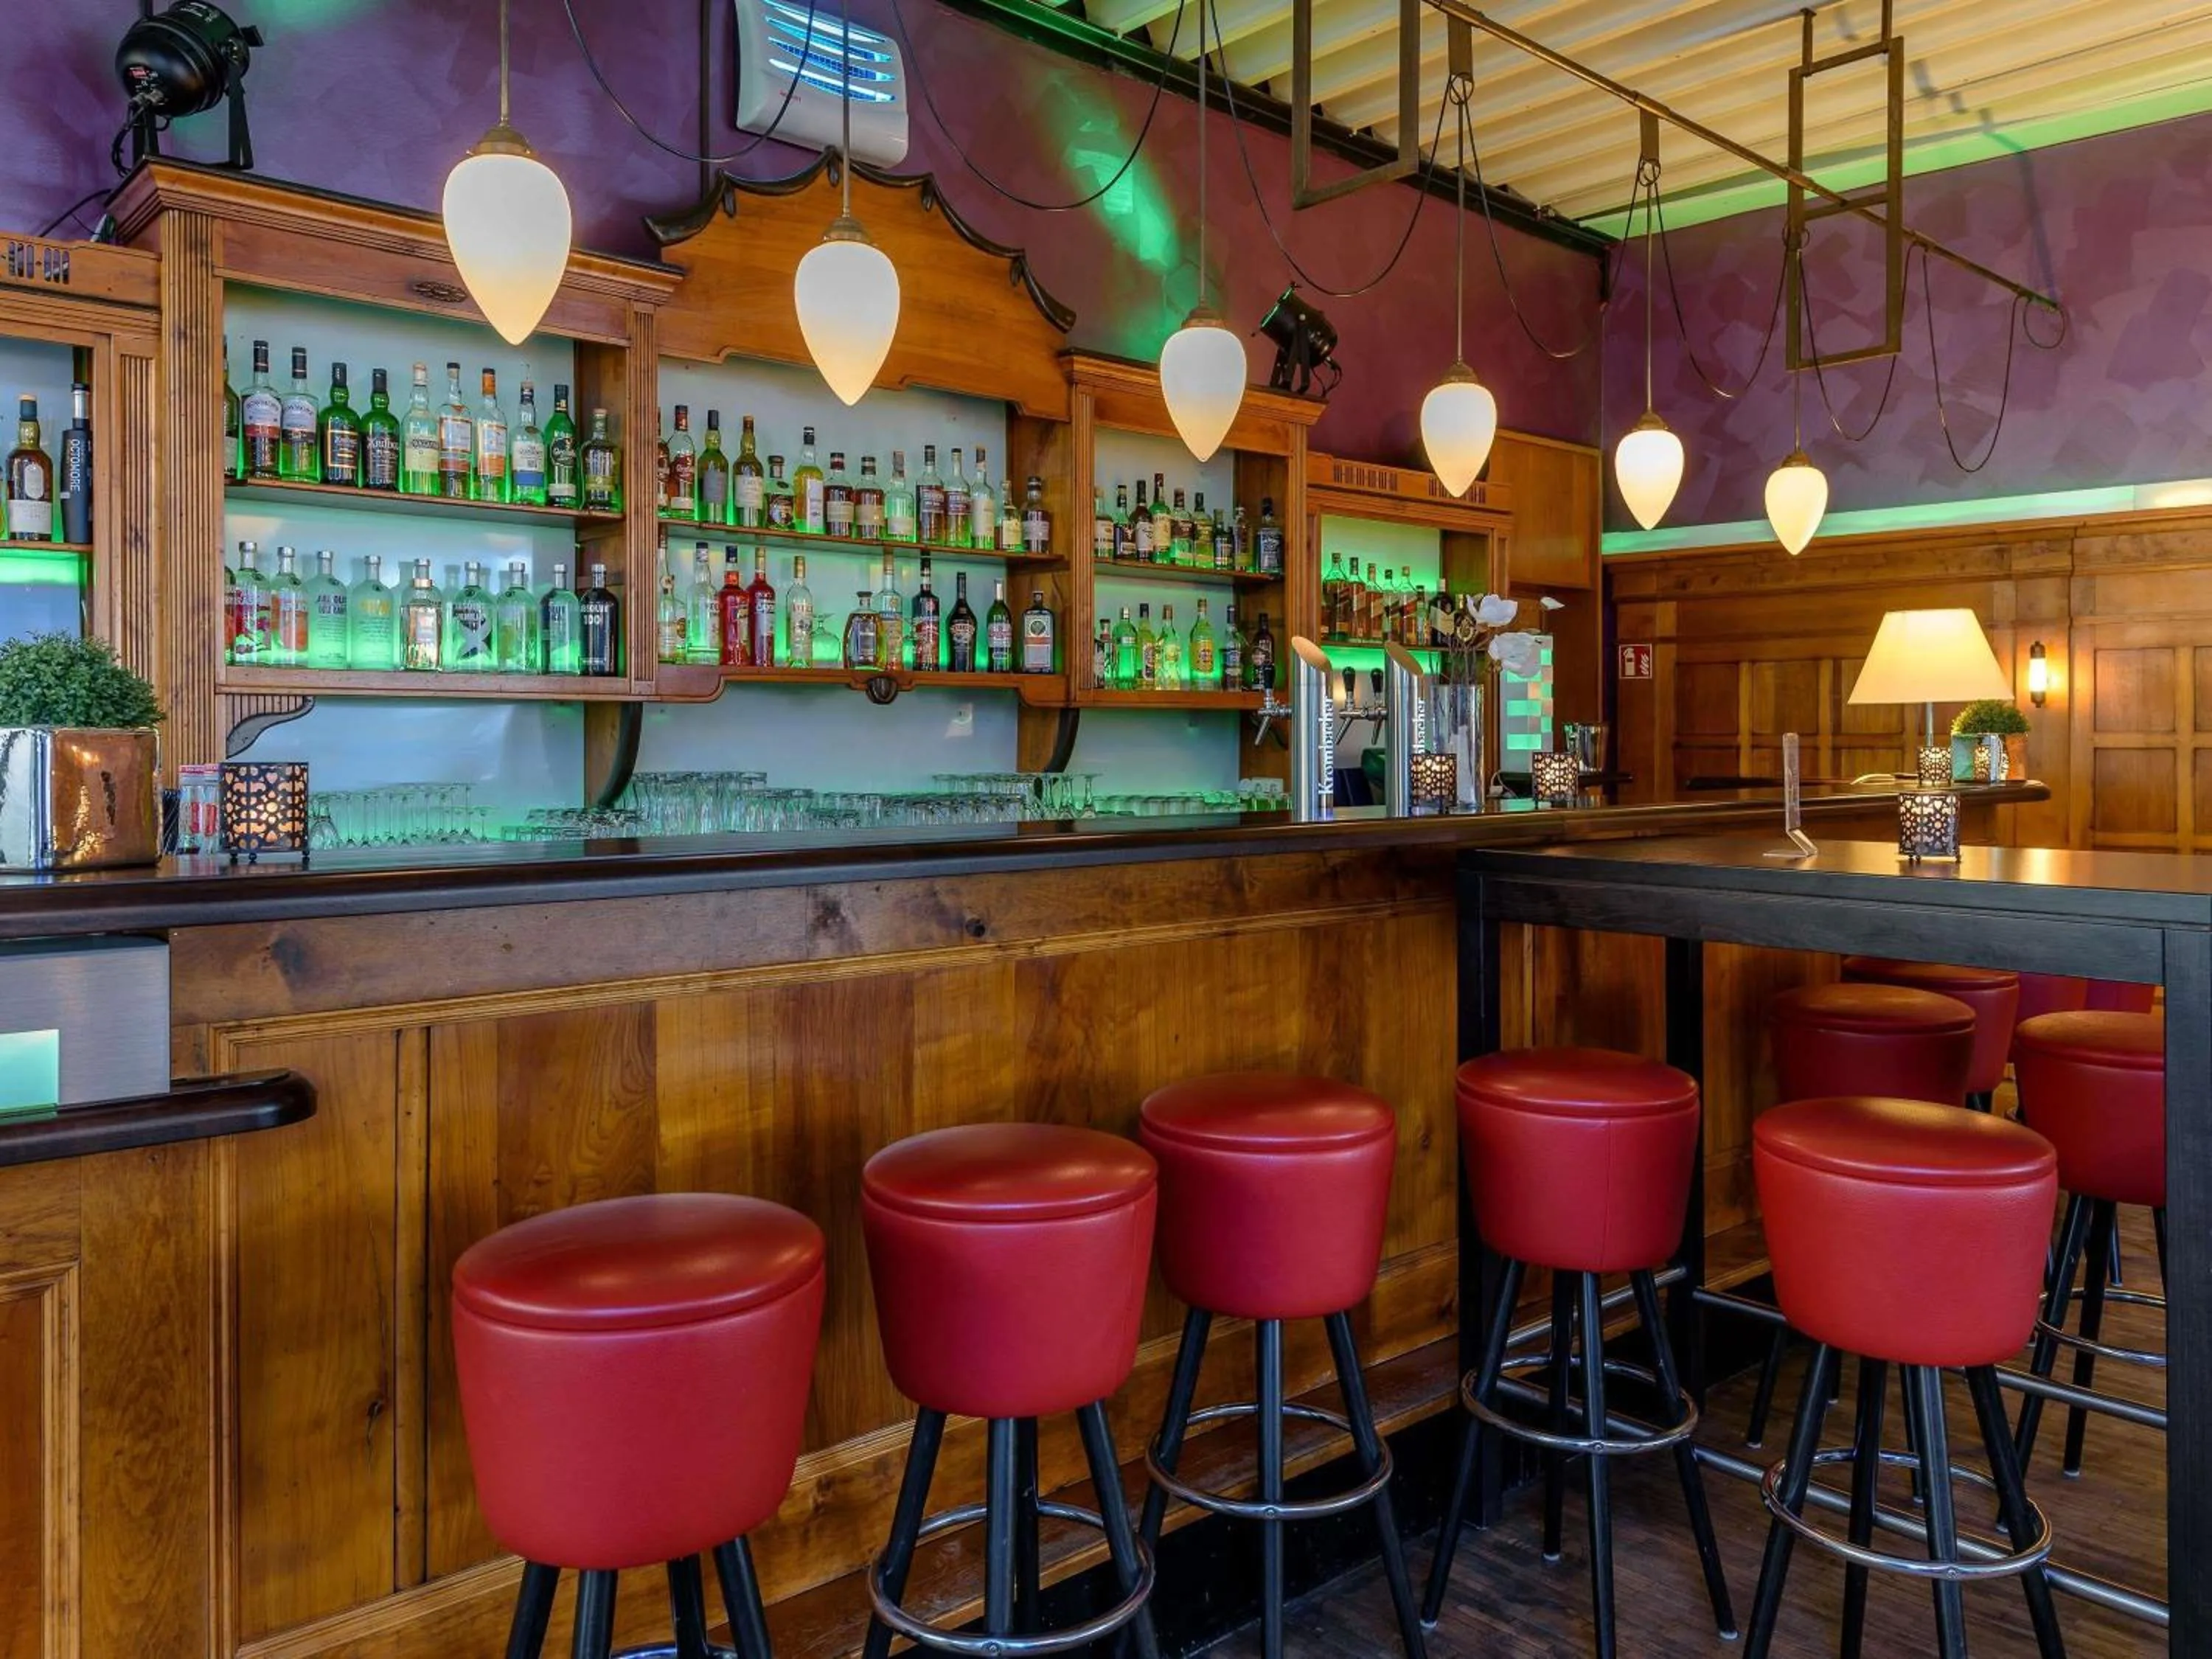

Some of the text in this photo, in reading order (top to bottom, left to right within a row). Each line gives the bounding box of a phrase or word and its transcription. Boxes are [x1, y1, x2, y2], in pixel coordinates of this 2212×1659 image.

[70, 438, 80, 493] OCTOMORE
[1318, 695, 1334, 794] Krombacher
[1411, 697, 1425, 754] bacher
